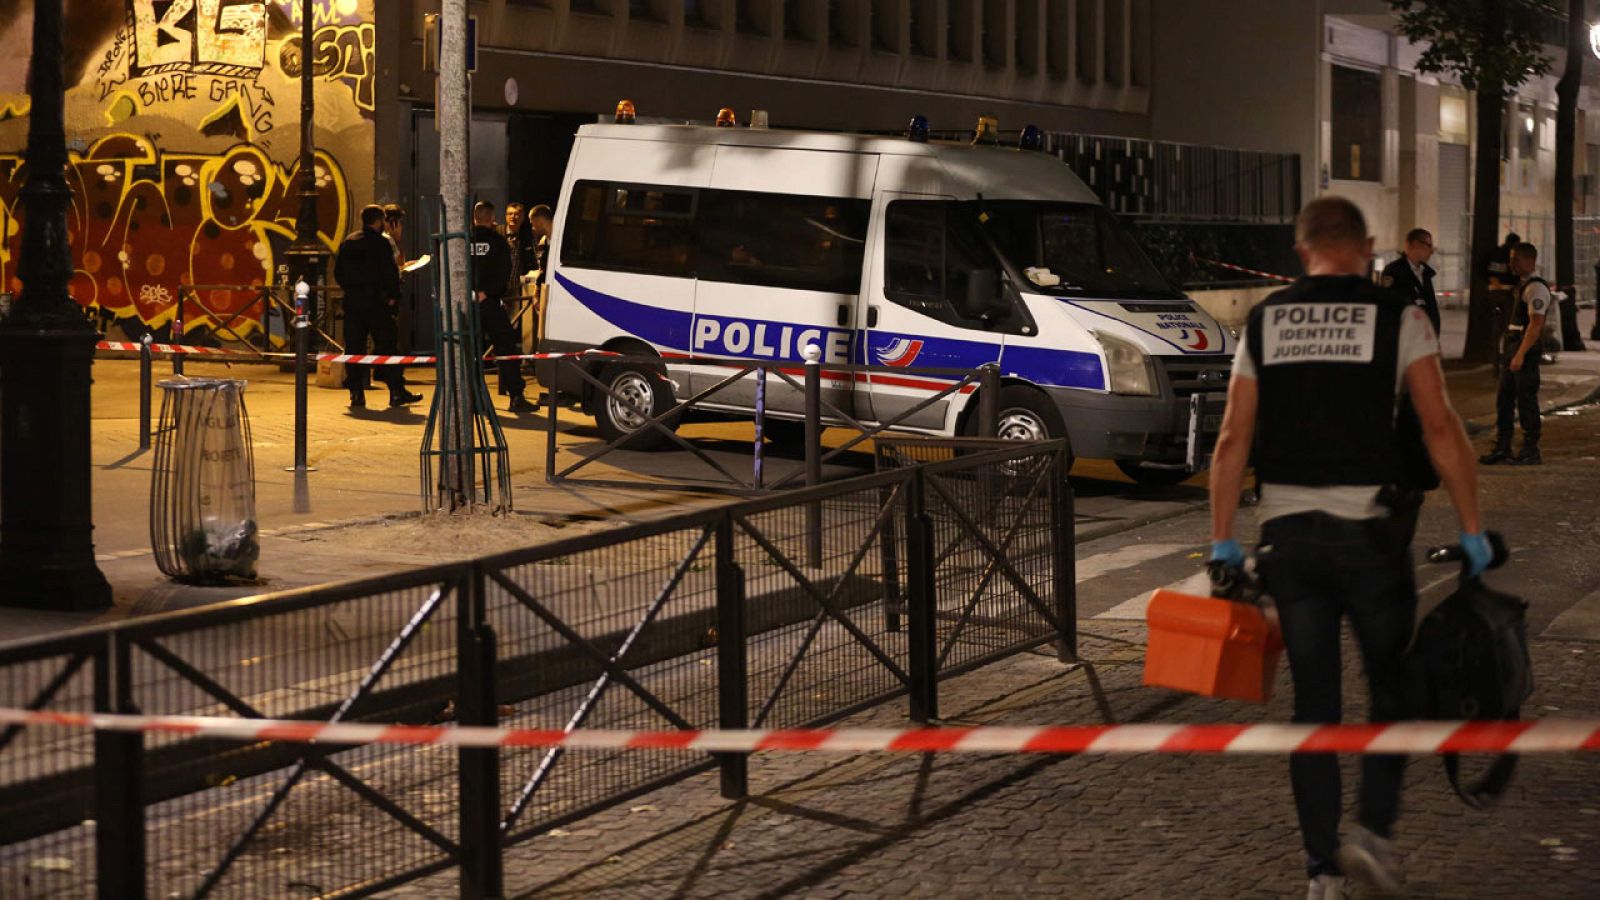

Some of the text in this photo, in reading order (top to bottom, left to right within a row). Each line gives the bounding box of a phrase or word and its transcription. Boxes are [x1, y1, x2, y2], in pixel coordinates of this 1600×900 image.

[209, 79, 273, 133] GANG
[1273, 307, 1366, 325] POLICE
[695, 318, 851, 366] POLICE
[1279, 328, 1356, 341] IDENTITE
[1272, 344, 1362, 358] JUDICIAIRE
